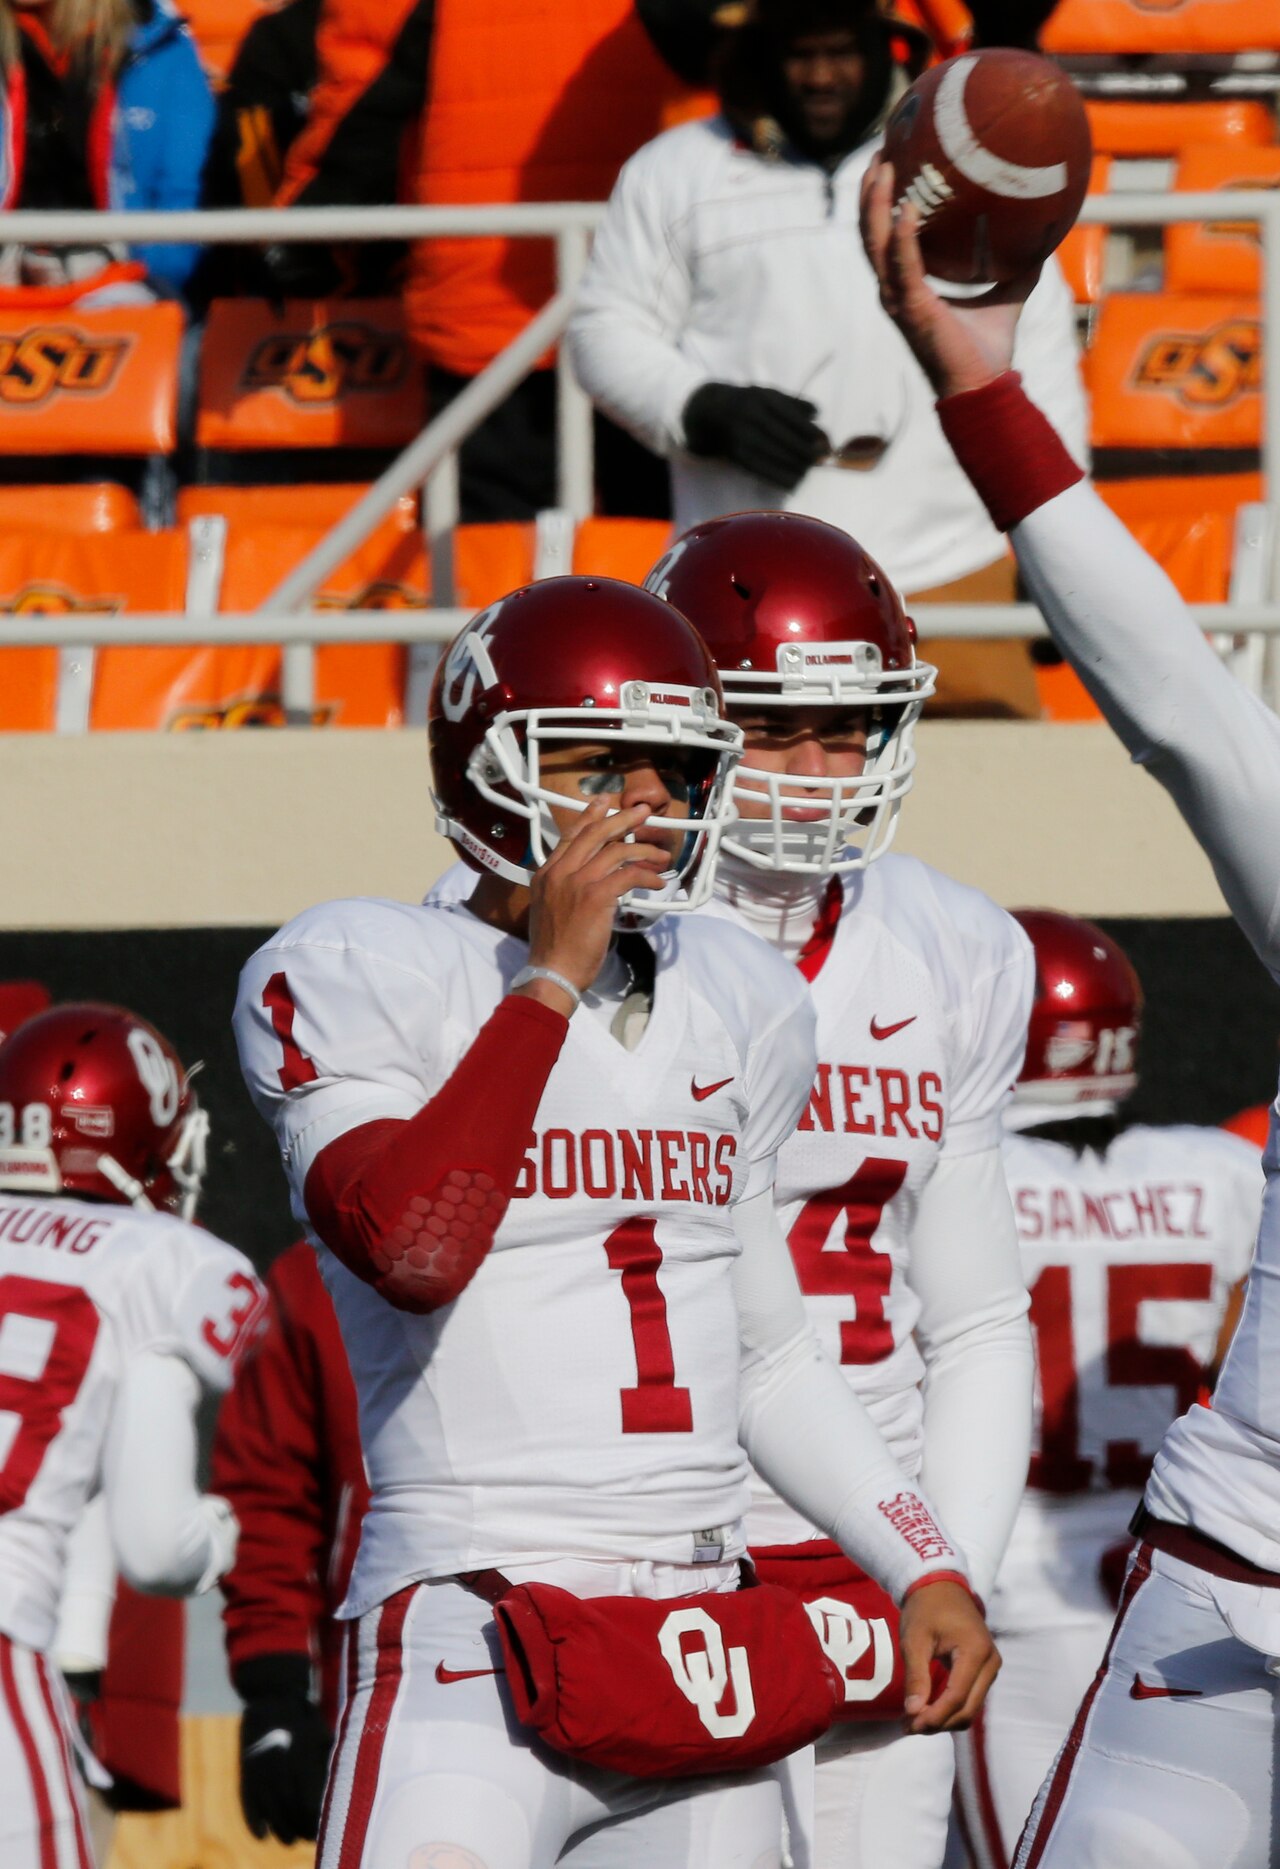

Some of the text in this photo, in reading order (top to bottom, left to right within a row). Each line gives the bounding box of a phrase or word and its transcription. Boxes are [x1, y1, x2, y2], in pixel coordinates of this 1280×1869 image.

[0, 327, 136, 405] SU
[262, 972, 319, 1092] 1
[786, 1157, 909, 1365] 4
[1015, 1181, 1212, 1241] SANCHEZ
[603, 1216, 693, 1434] 1
[1027, 1263, 1213, 1493] 15
[657, 1607, 756, 1739] OU
